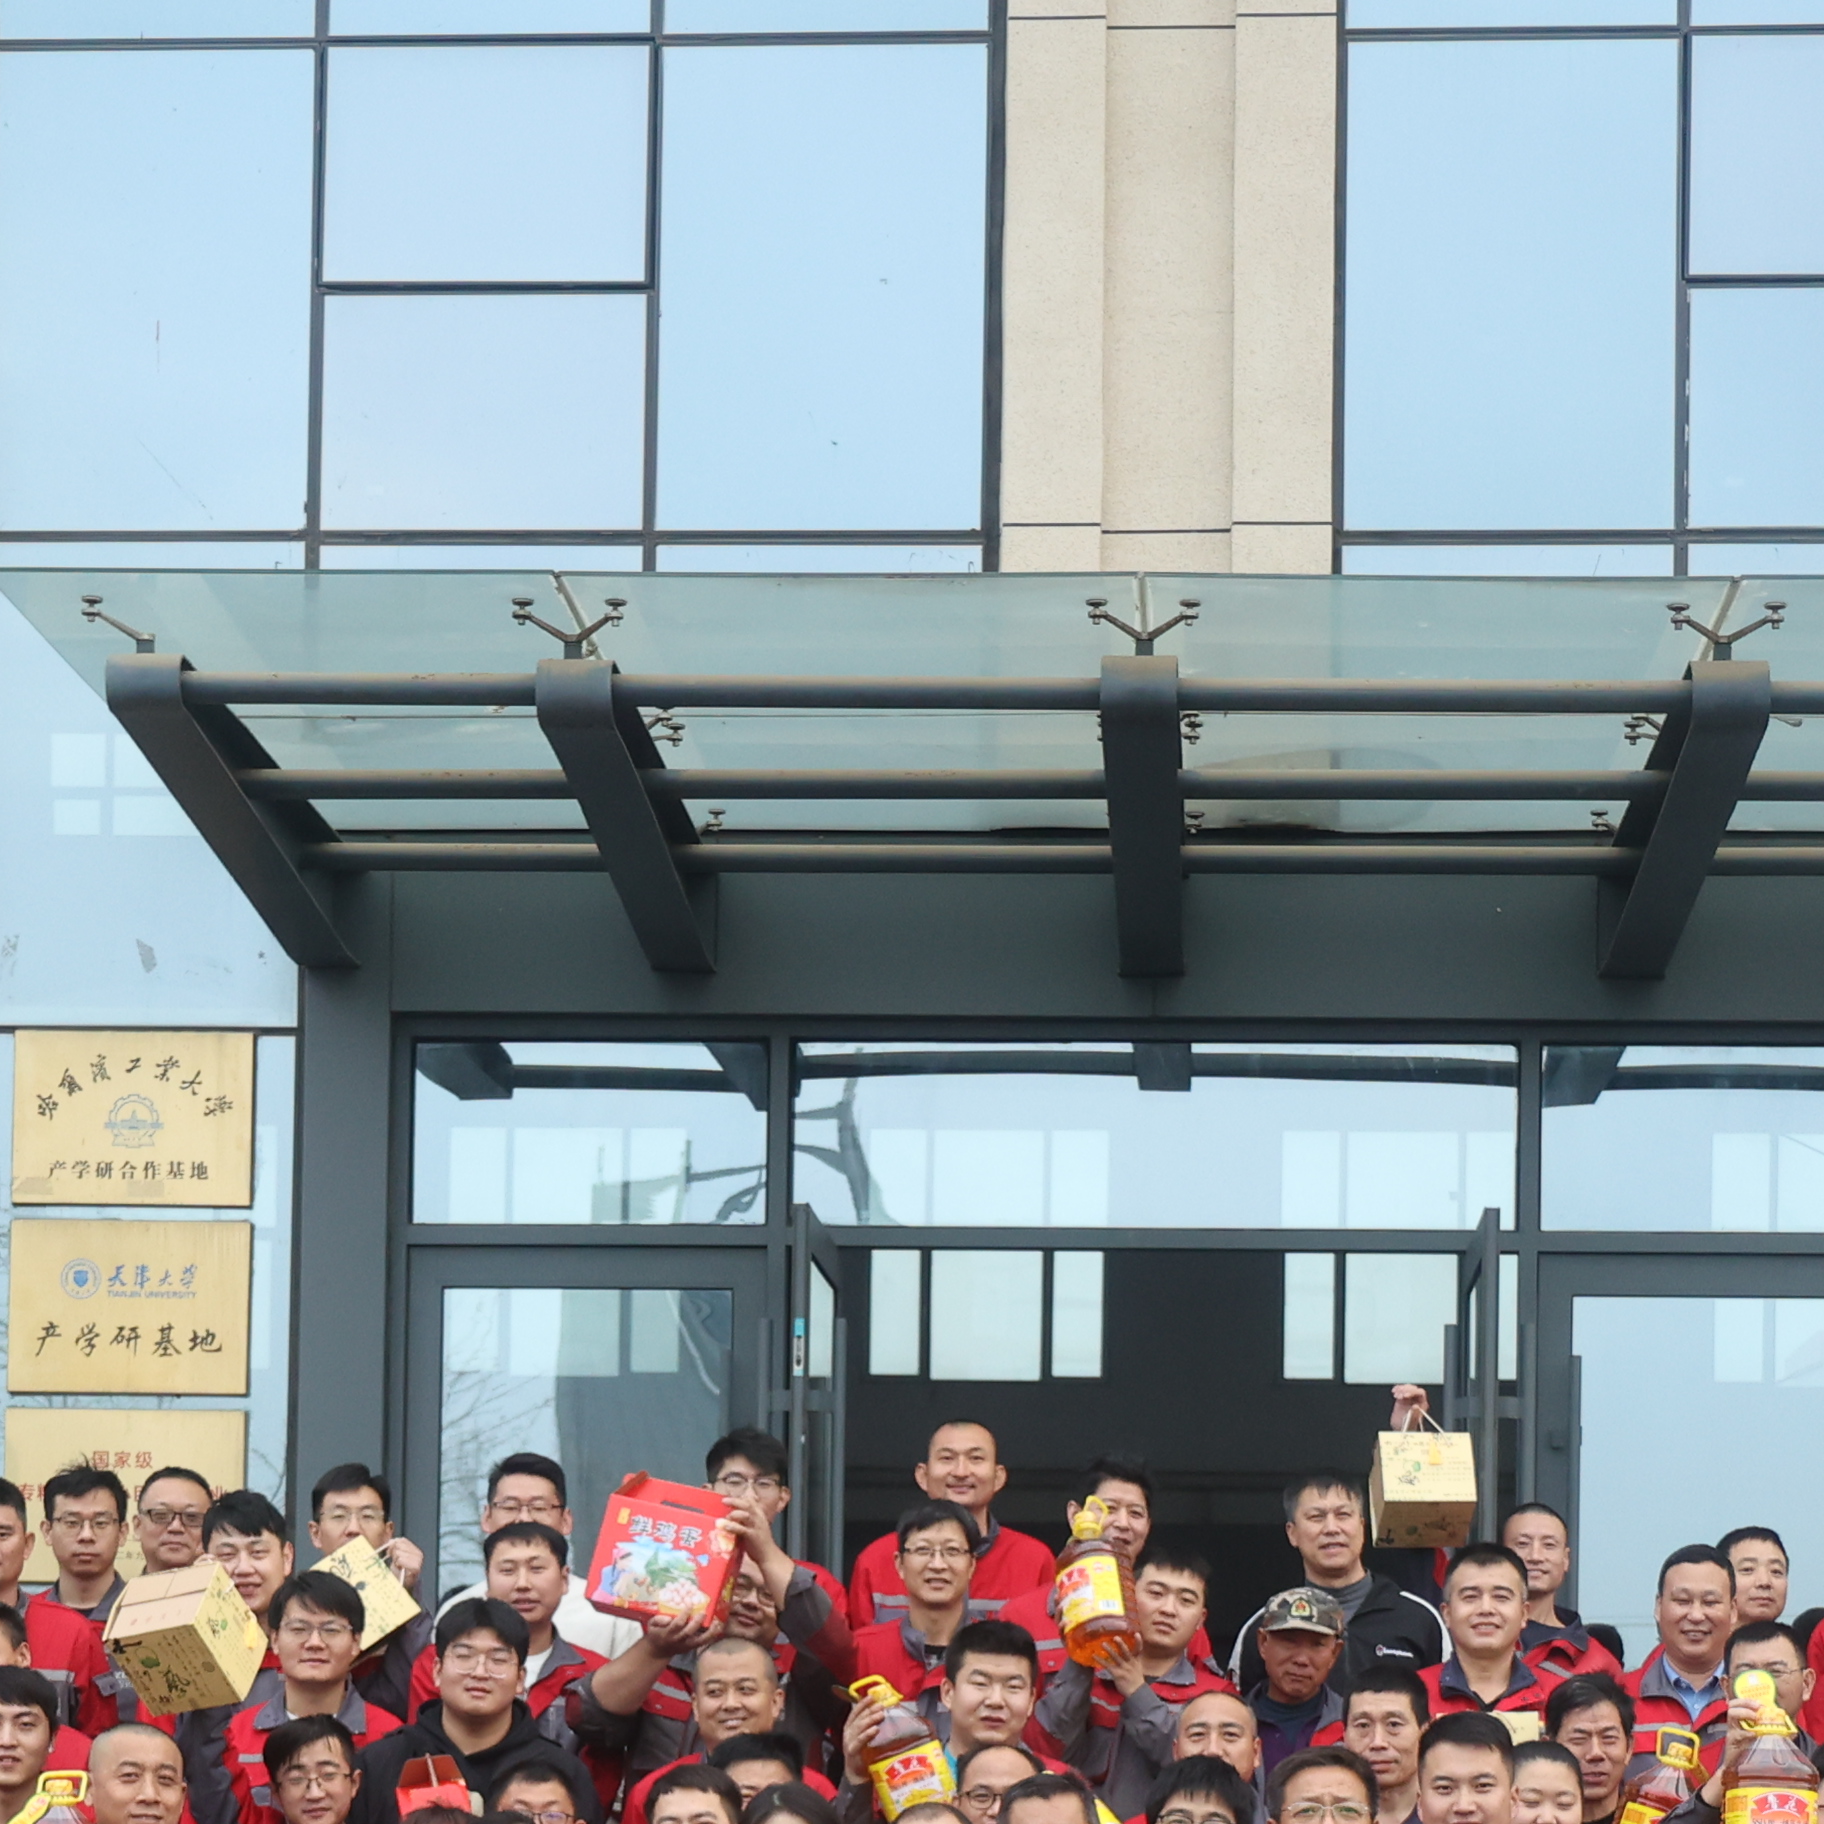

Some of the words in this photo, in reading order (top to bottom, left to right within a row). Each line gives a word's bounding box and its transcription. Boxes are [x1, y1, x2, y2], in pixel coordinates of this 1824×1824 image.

[47, 1160, 210, 1180] 产学研合作基地
[107, 1290, 142, 1299] TIANJIN
[144, 1290, 198, 1300] UNIVERSITY
[34, 1320, 223, 1358] 产学研基地
[92, 1450, 154, 1469] 国家级
[629, 1514, 703, 1549] 鲜鸡蛋
[1765, 1794, 1799, 1812] 鲁花
